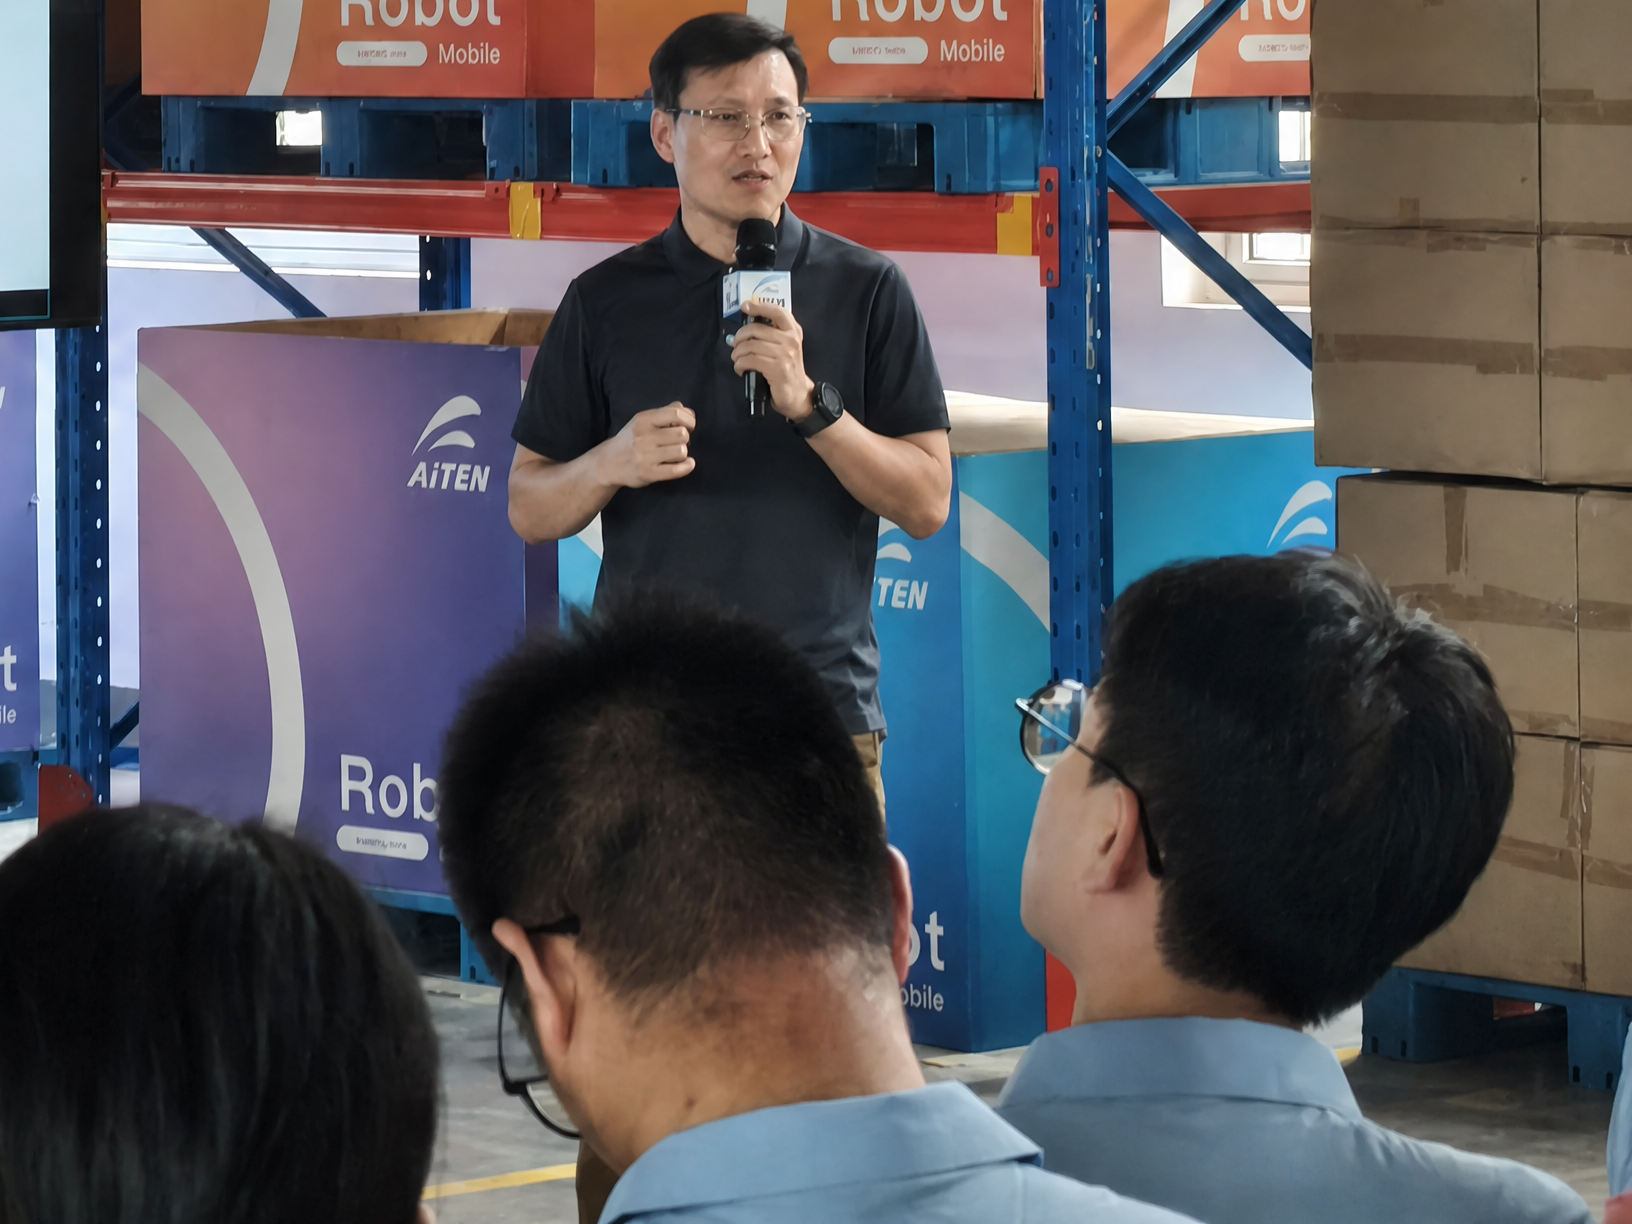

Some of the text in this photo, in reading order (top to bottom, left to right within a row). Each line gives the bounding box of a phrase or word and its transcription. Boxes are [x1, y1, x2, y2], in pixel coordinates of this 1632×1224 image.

[438, 42, 501, 65] Mobile
[939, 38, 1005, 62] Mobile
[406, 461, 491, 493] AiTEN
[874, 576, 929, 611] TEN
[340, 754, 440, 823] Rob
[901, 983, 944, 1012] obile
